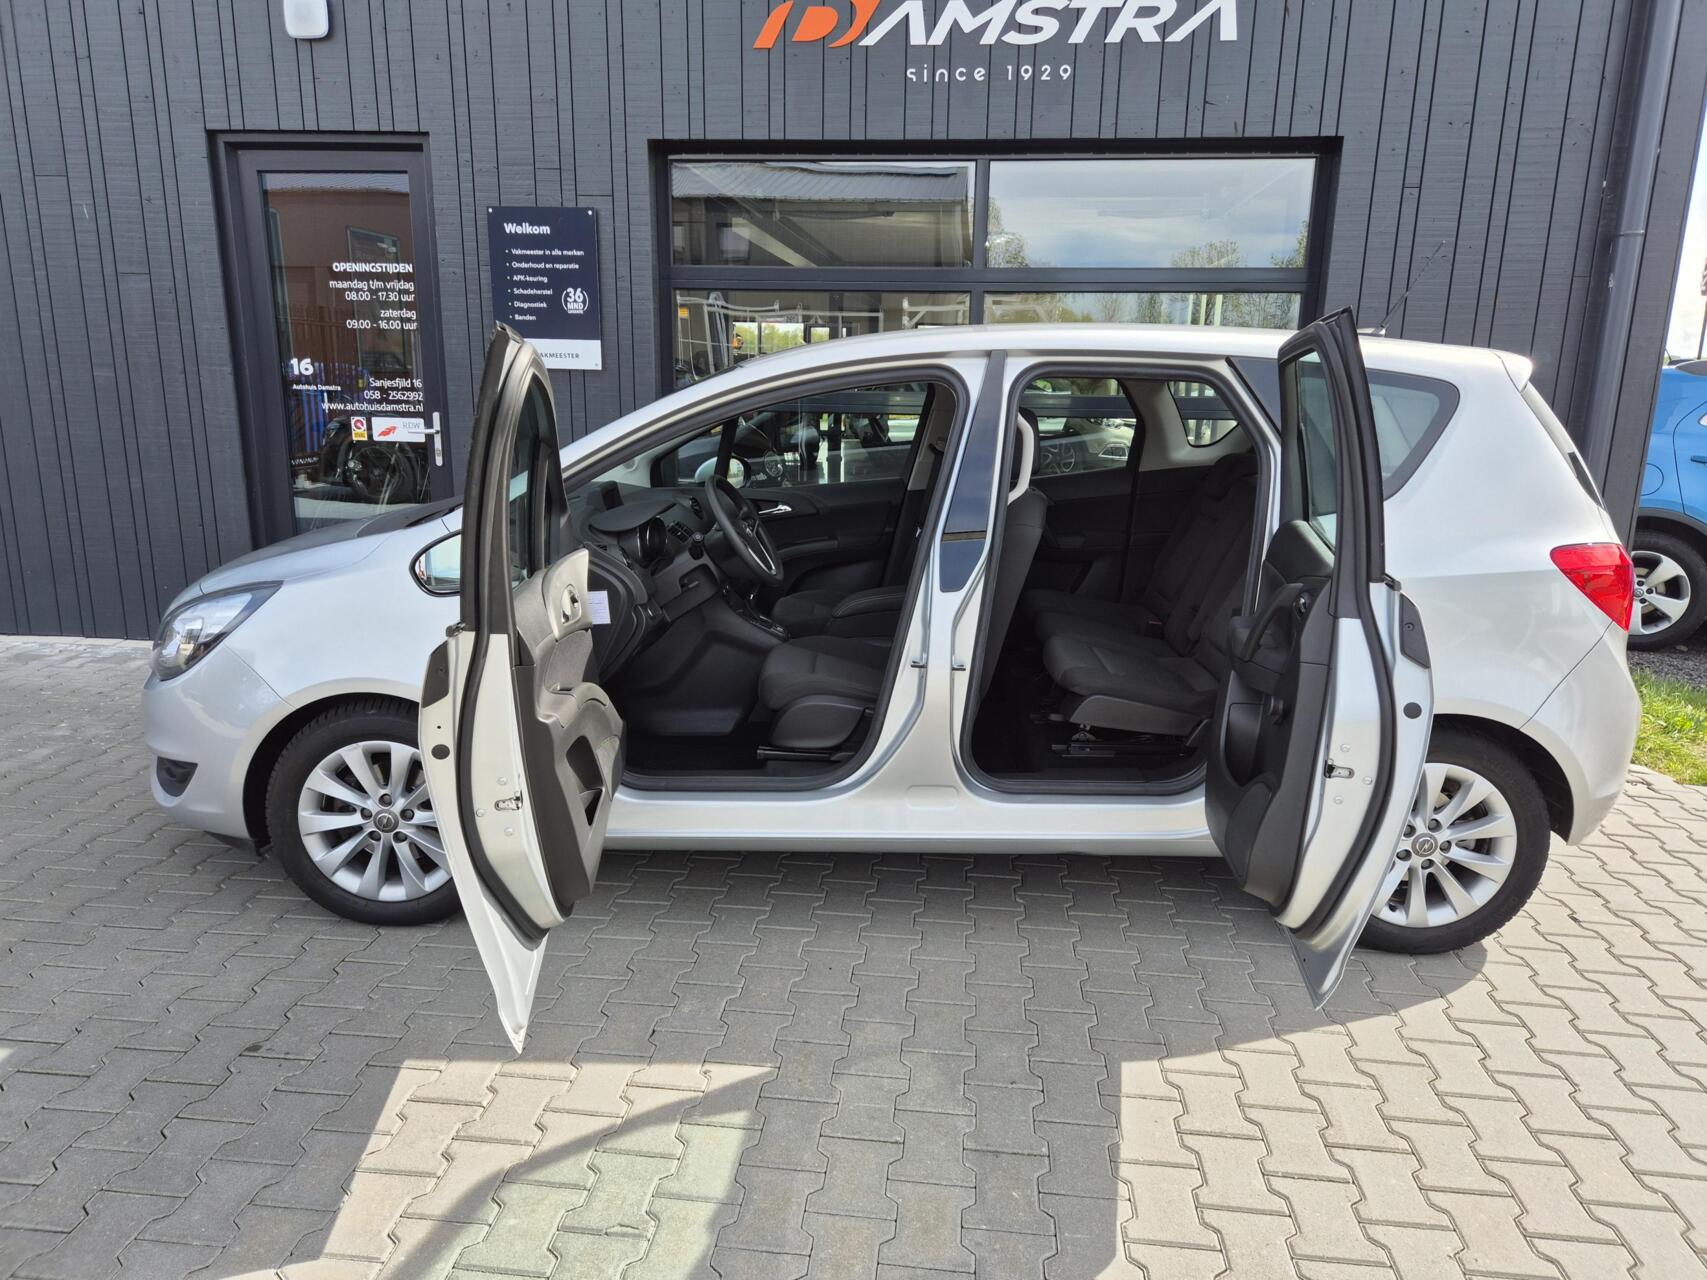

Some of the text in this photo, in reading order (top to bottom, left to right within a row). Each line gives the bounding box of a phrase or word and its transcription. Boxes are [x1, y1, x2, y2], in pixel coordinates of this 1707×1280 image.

[906, 64, 1073, 82] since 1929
[504, 222, 551, 235] Welkom
[511, 248, 544, 256] Vakmeester
[551, 248, 562, 256] alle
[332, 262, 413, 275] OPENINGSTIJDEN
[511, 261, 545, 269] Onderhoud
[554, 262, 579, 270] reparatie
[512, 275, 548, 283] APK-keuring
[329, 280, 414, 292] maandag t/m vrijdag
[513, 287, 553, 295] Schadeherstel
[345, 292, 371, 302] 08.00
[377, 292, 400, 302] 17.30
[401, 294, 415, 302] uur
[566, 287, 584, 302] 36
[379, 308, 417, 319] zaterdag
[346, 319, 372, 329] 09.00
[378, 320, 402, 330] 16.00
[402, 322, 417, 330] uur
[290, 357, 314, 376] 16
[412, 378, 423, 388] 16
[363, 390, 381, 400] 058
[388, 390, 424, 401] 2562992
[322, 401, 424, 413] www.autohuisdamstra.nl
